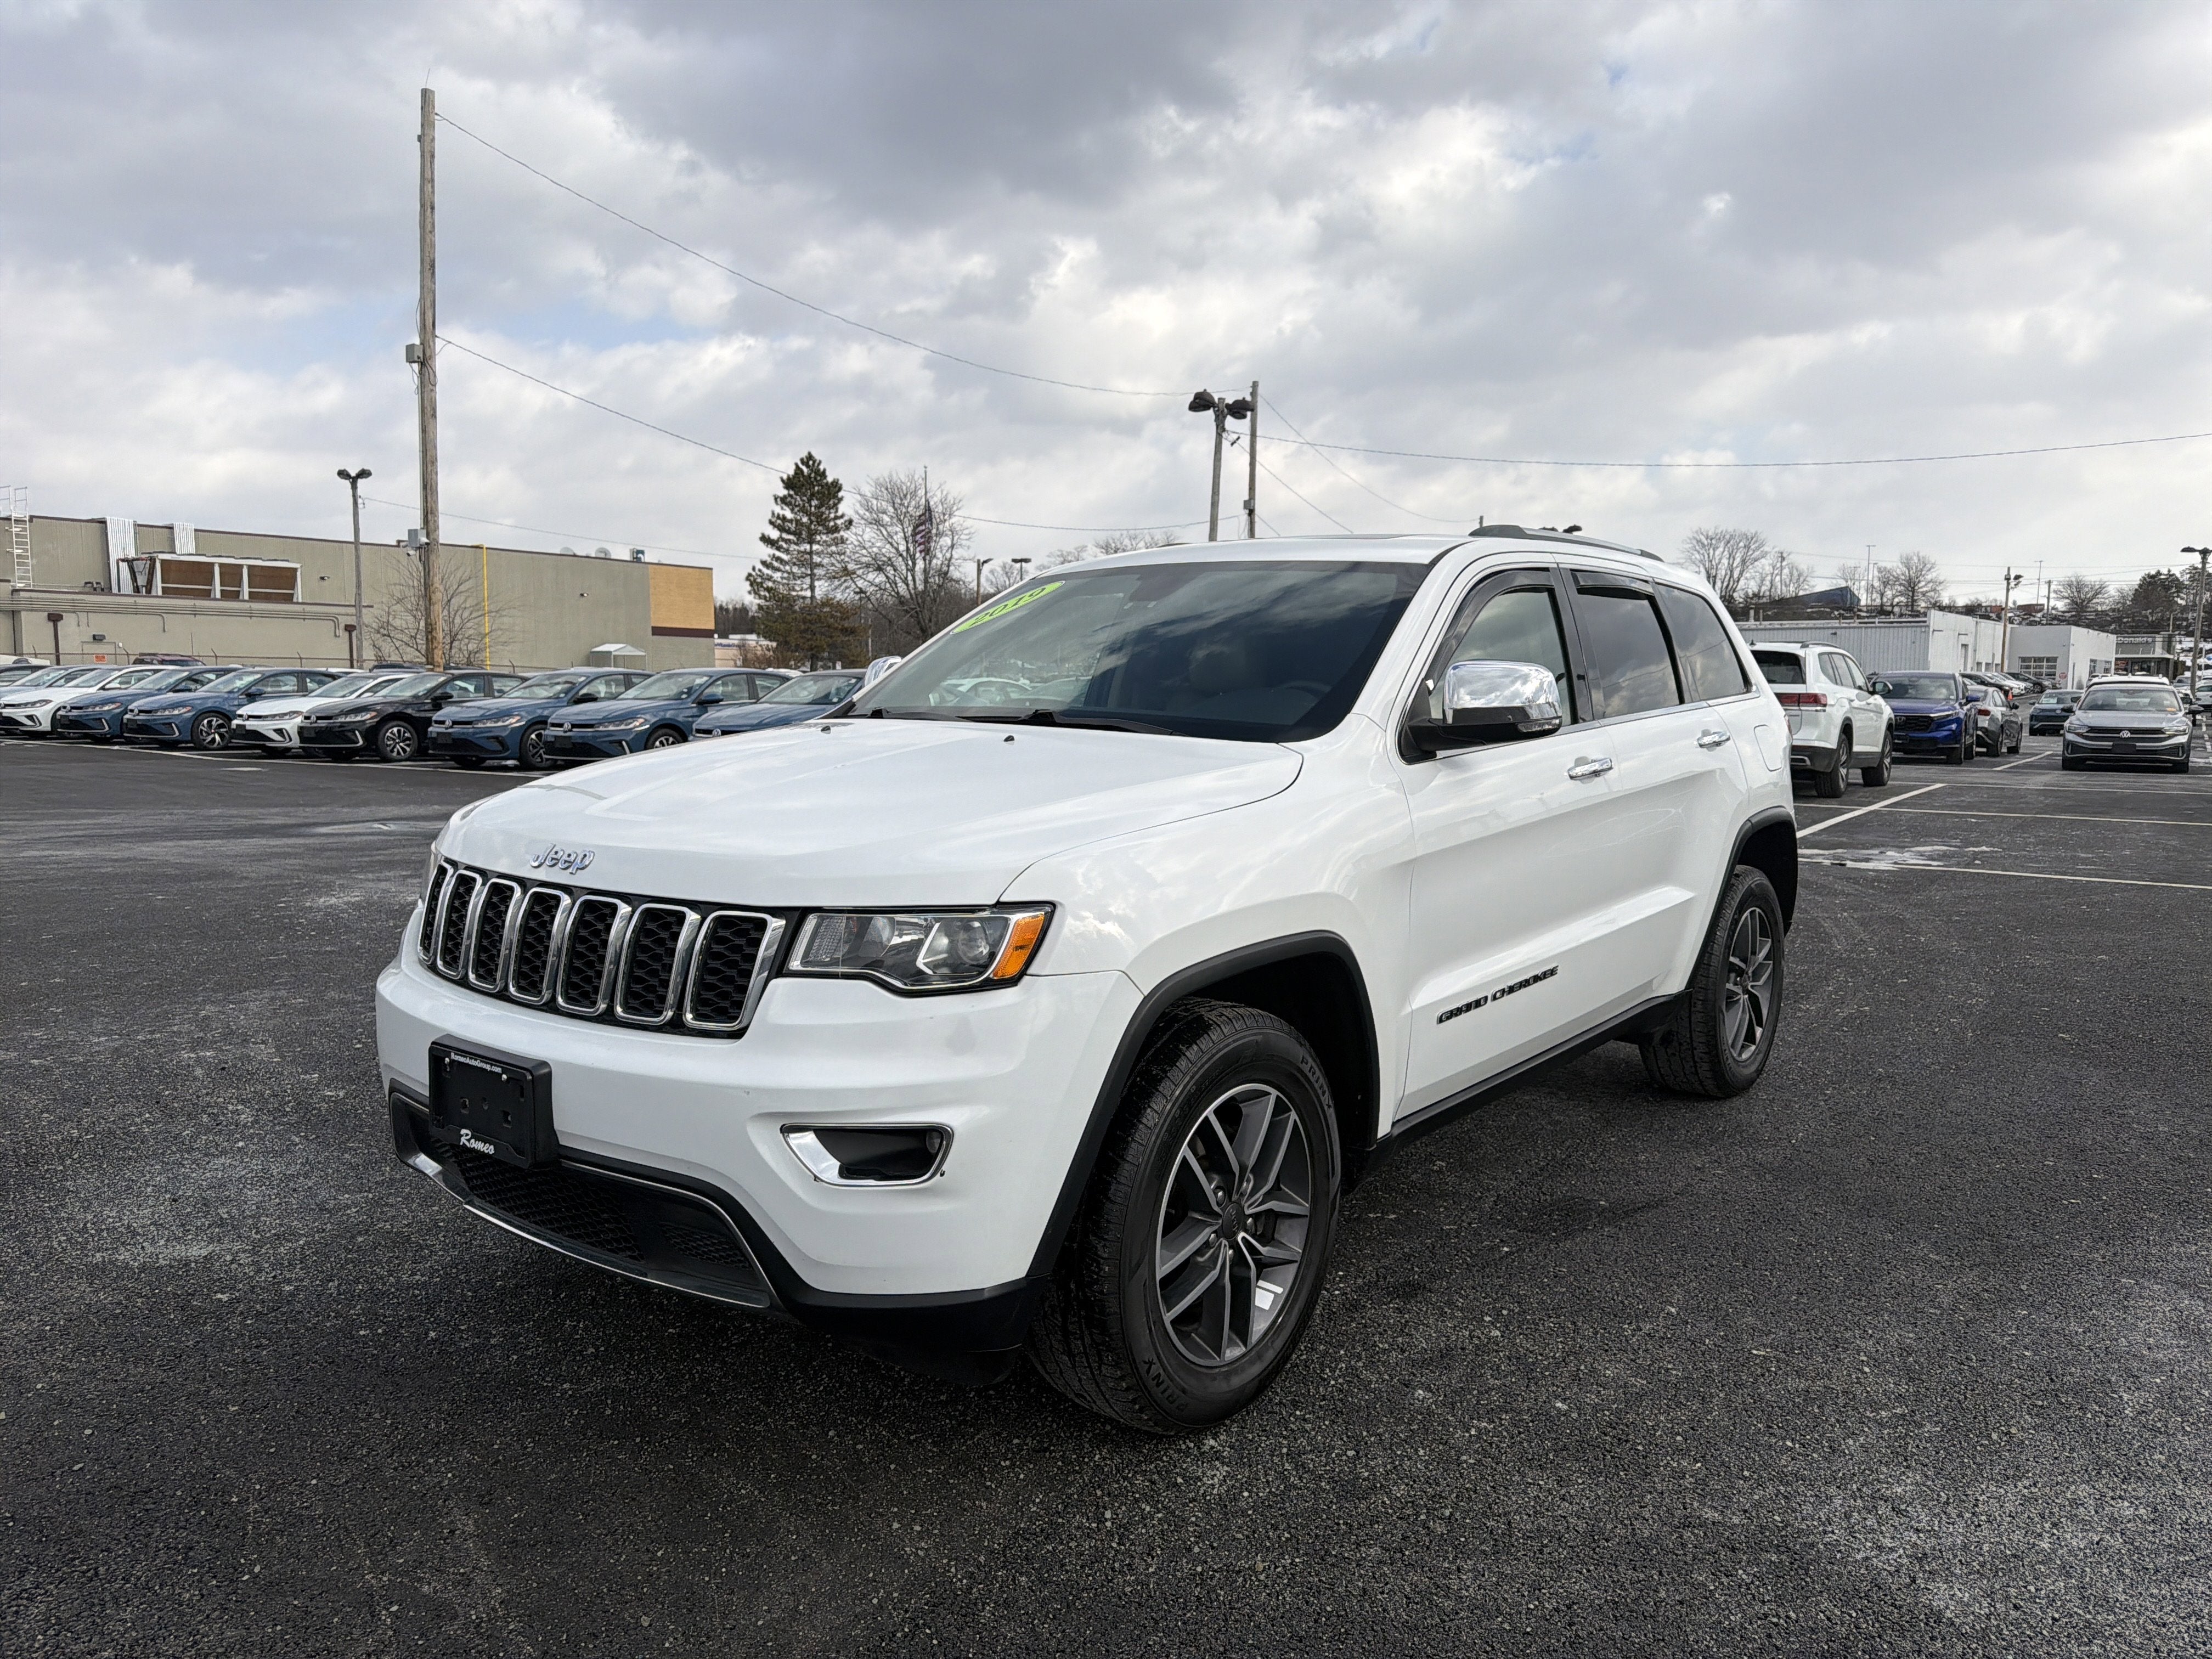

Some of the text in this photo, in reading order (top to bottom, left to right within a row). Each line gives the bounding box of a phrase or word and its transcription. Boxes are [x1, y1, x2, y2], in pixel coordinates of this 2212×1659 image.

[968, 586, 1047, 627] 2019
[531, 843, 595, 874] Jeep
[1436, 964, 1559, 1025] GRAND CHEROKEE
[451, 1052, 502, 1074] RomeoAutoGroup.com
[460, 1128, 495, 1154] Romeo
